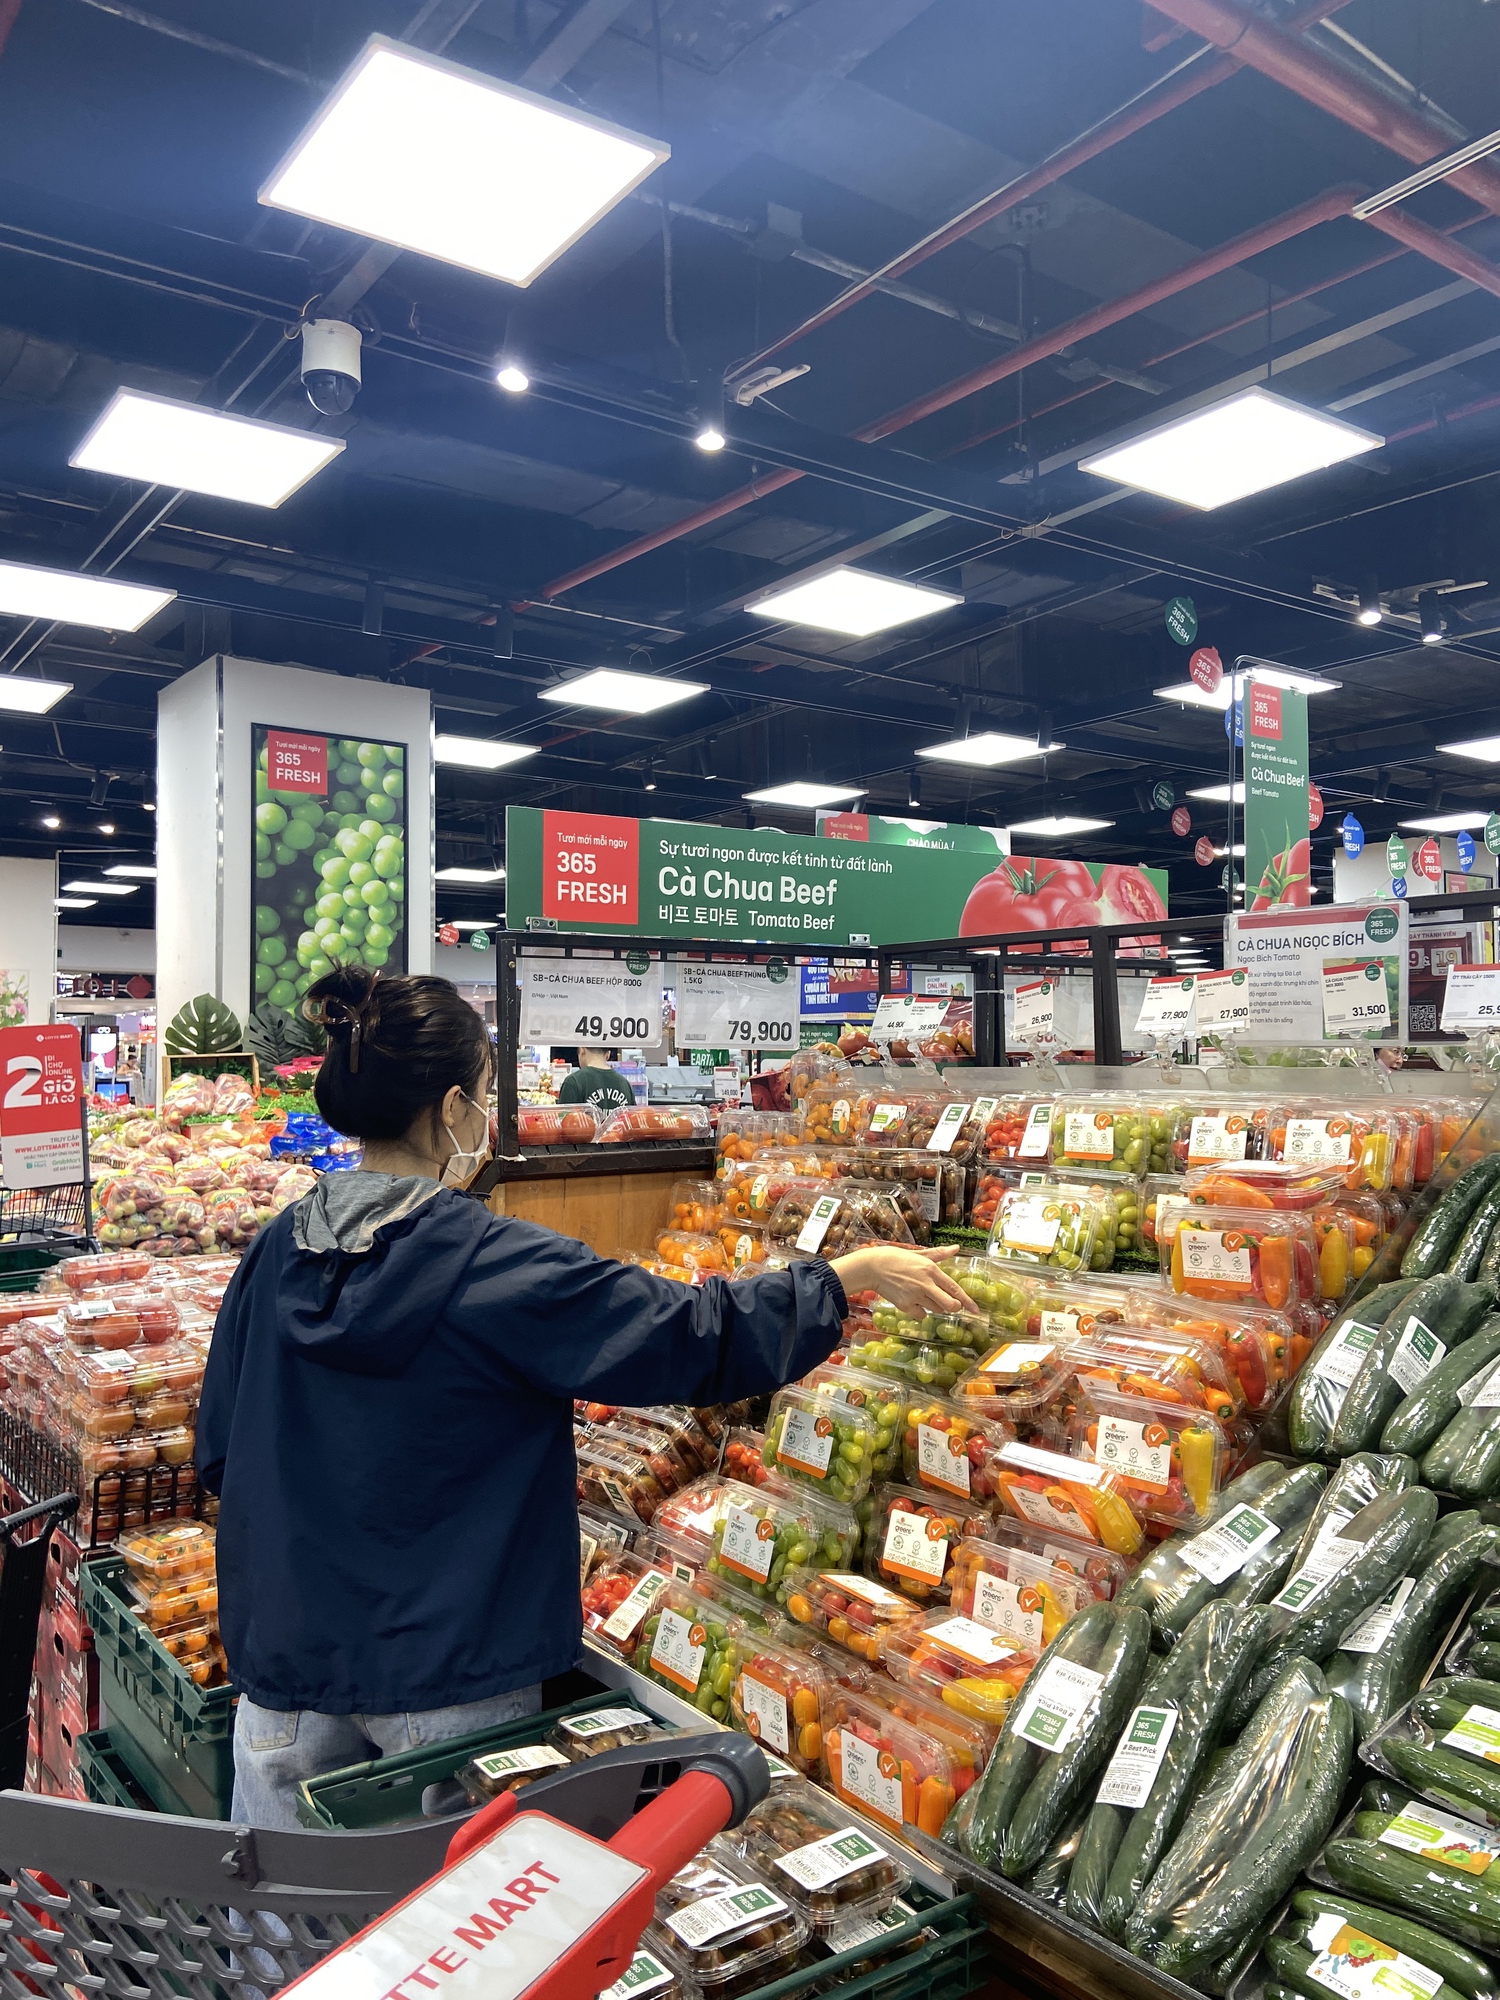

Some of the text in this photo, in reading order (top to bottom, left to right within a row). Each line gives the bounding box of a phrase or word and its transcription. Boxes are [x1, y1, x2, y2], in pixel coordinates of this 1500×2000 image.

[1172, 606, 1186, 624] 365
[1168, 615, 1190, 643] FRESH
[1196, 659, 1212, 674] 365
[1193, 668, 1218, 692] FRESH
[1254, 700, 1268, 714] 365
[1254, 715, 1279, 731] FRESH
[307, 745, 321, 754] ngày
[275, 751, 301, 766] 365
[275, 767, 321, 784] FRESH
[1251, 766, 1305, 788] Cà Chua Beef
[1251, 787, 1280, 798] Beef Tomato
[556, 831, 628, 850] Tươi mới mỗi ngày
[1344, 842, 1360, 852] FRESH
[659, 839, 893, 874] Sự tươi ngon được kết tinh từ đất lành
[1389, 851, 1398, 861] 365
[1424, 855, 1435, 864] 365
[556, 851, 597, 875] 365
[1390, 861, 1407, 871] FRESH
[1425, 865, 1442, 875] FRESH
[557, 880, 627, 905] FRESH
[658, 865, 838, 907] Cà Chua Beef
[658, 904, 836, 931] 비프 토마토 Tomato Beef
[1370, 920, 1384, 928] 365
[1370, 927, 1394, 936] FRESH
[1409, 931, 1421, 940] GÀY
[1421, 930, 1442, 938] THÀNH
[1237, 930, 1364, 952] CÀ CHUA NGỌC BÍCH
[1273, 953, 1301, 962] Tomato
[1422, 955, 1431, 967] &
[1436, 949, 1458, 968] 19
[628, 962, 648, 971] FRESH
[683, 966, 767, 979] SB-CÀ CHUA BEEF THÙNG
[532, 972, 643, 989] SB-CÀ CHUA BEEF HỘP 800G
[927, 982, 948, 990] ONLINE
[1161, 1010, 1189, 1020] 27,900
[1219, 1007, 1248, 1019] 27,900
[1352, 1004, 1386, 1017] 31,500
[1478, 1005, 1500, 1016] 25,9
[574, 1015, 650, 1042] 49,900
[727, 1019, 792, 1044] 79,900
[47, 1061, 64, 1069] CHỢ
[48, 1067, 73, 1076] ONLINE
[3, 1055, 43, 1109] 2
[60, 1090, 76, 1104] CÓ
[586, 1087, 629, 1109] NEW YORK
[50, 1134, 80, 1144] TRUY CẬP
[14, 1141, 80, 1154] WWW.LOTTEMART.VN
[1350, 1332, 1365, 1341] 365
[1416, 1333, 1426, 1345] 365
[1347, 1337, 1371, 1350] FRESH
[1414, 1338, 1430, 1357] FRESH
[1237, 1516, 1252, 1528] 365
[1232, 1521, 1254, 1539] FRESH
[1223, 1529, 1238, 1543] Best
[1236, 1537, 1249, 1551] Pick
[1037, 1698, 1052, 1709] Pick
[1052, 1703, 1068, 1715] Best
[1035, 1711, 1062, 1728] FRESH
[1136, 1721, 1150, 1730] 365
[1042, 1724, 1058, 1735] 365
[1132, 1729, 1157, 1740] FRESH
[1127, 1744, 1142, 1753] Best
[1143, 1745, 1158, 1755] Pick
[837, 1841, 860, 1858] FRESH
[845, 1838, 859, 1849] 365
[825, 1846, 850, 1867] Best Pick
[736, 1895, 756, 1911] FRESH
[745, 1892, 758, 1902] 365
[374, 1858, 562, 2000] TTE MART
